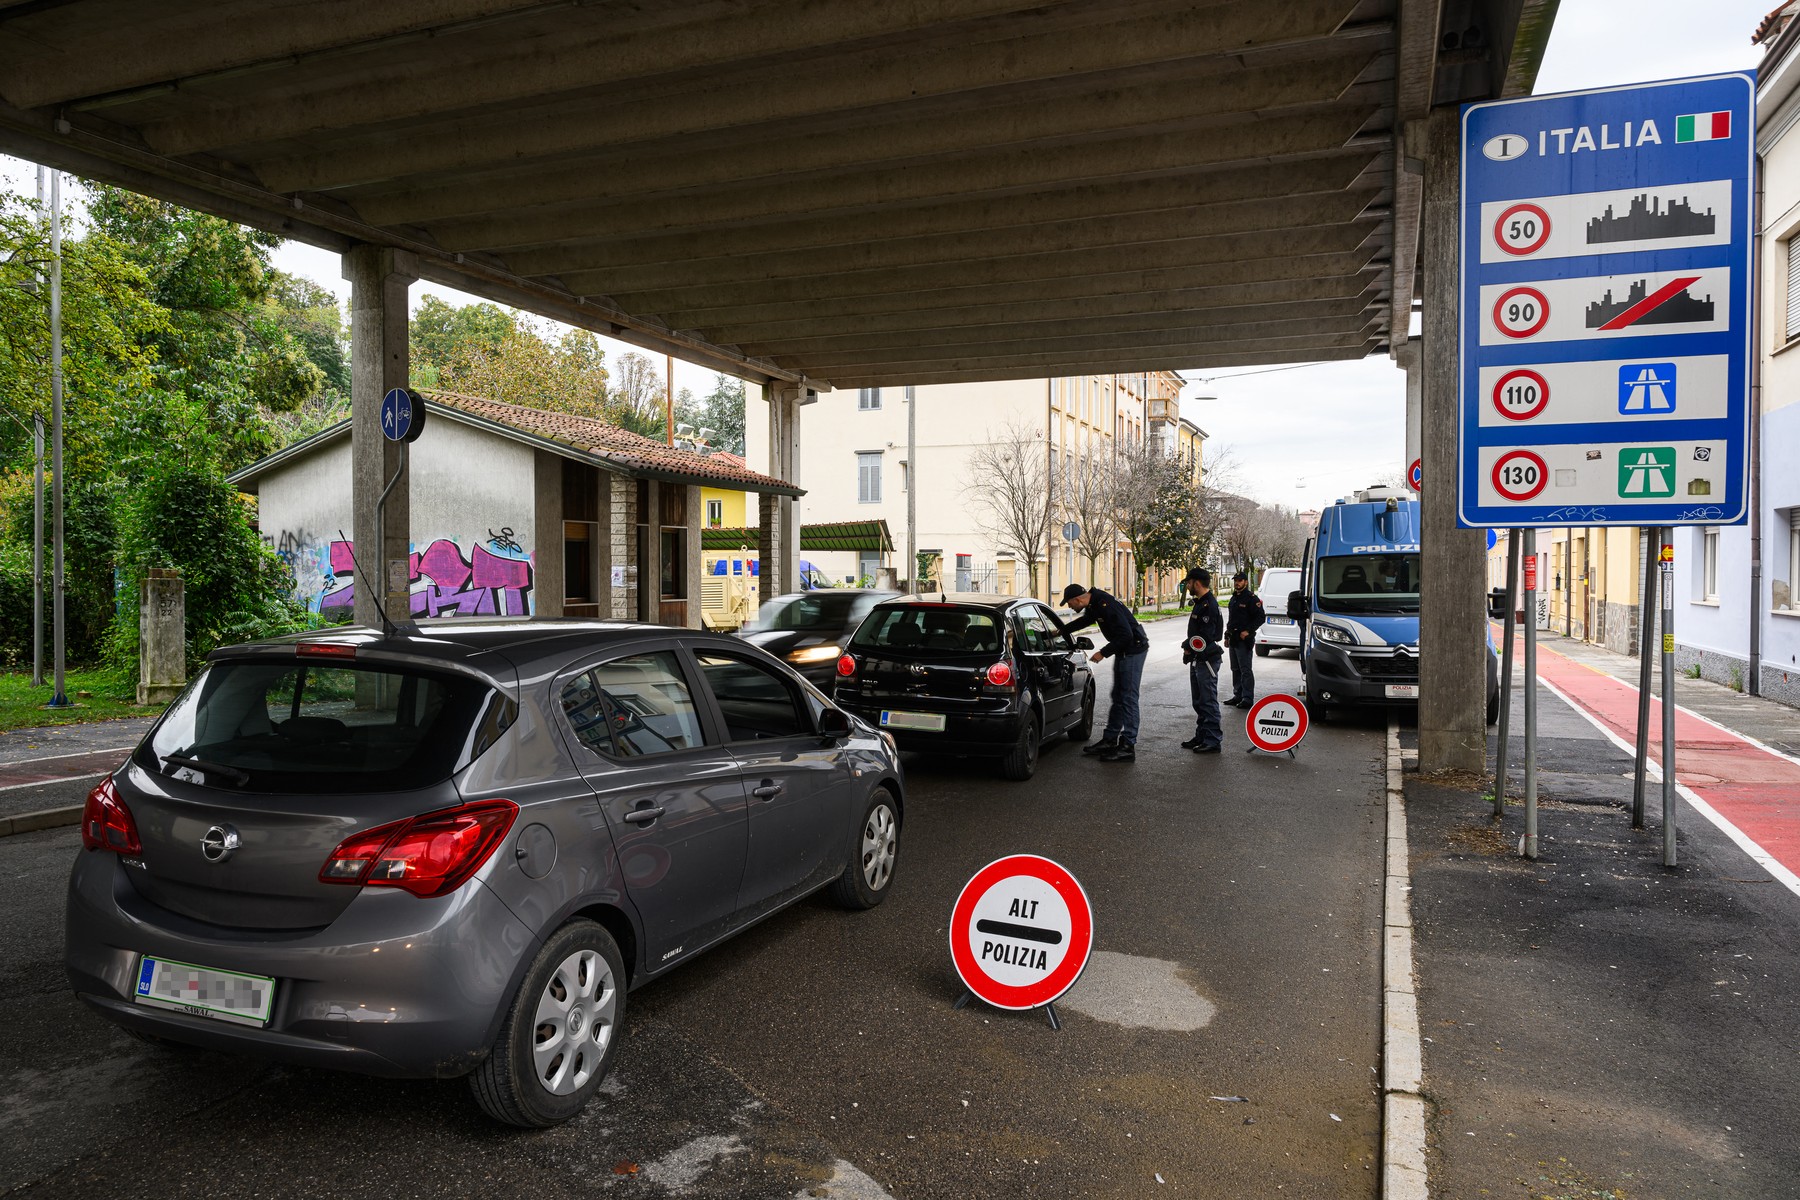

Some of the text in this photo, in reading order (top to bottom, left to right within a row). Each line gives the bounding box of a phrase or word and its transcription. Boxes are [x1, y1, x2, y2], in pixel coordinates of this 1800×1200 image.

[1498, 119, 1662, 157] I ITALIA
[1509, 219, 1536, 240] 50
[1508, 303, 1535, 322] 90
[1506, 385, 1537, 405] 110
[1503, 466, 1537, 485] 130
[1352, 544, 1421, 553] POLIZI
[1271, 710, 1285, 719] ALT
[1260, 726, 1289, 737] POLIZIA
[1008, 897, 1039, 920] ALT
[981, 940, 1048, 971] POLIZIA
[139, 982, 150, 992] SLO
